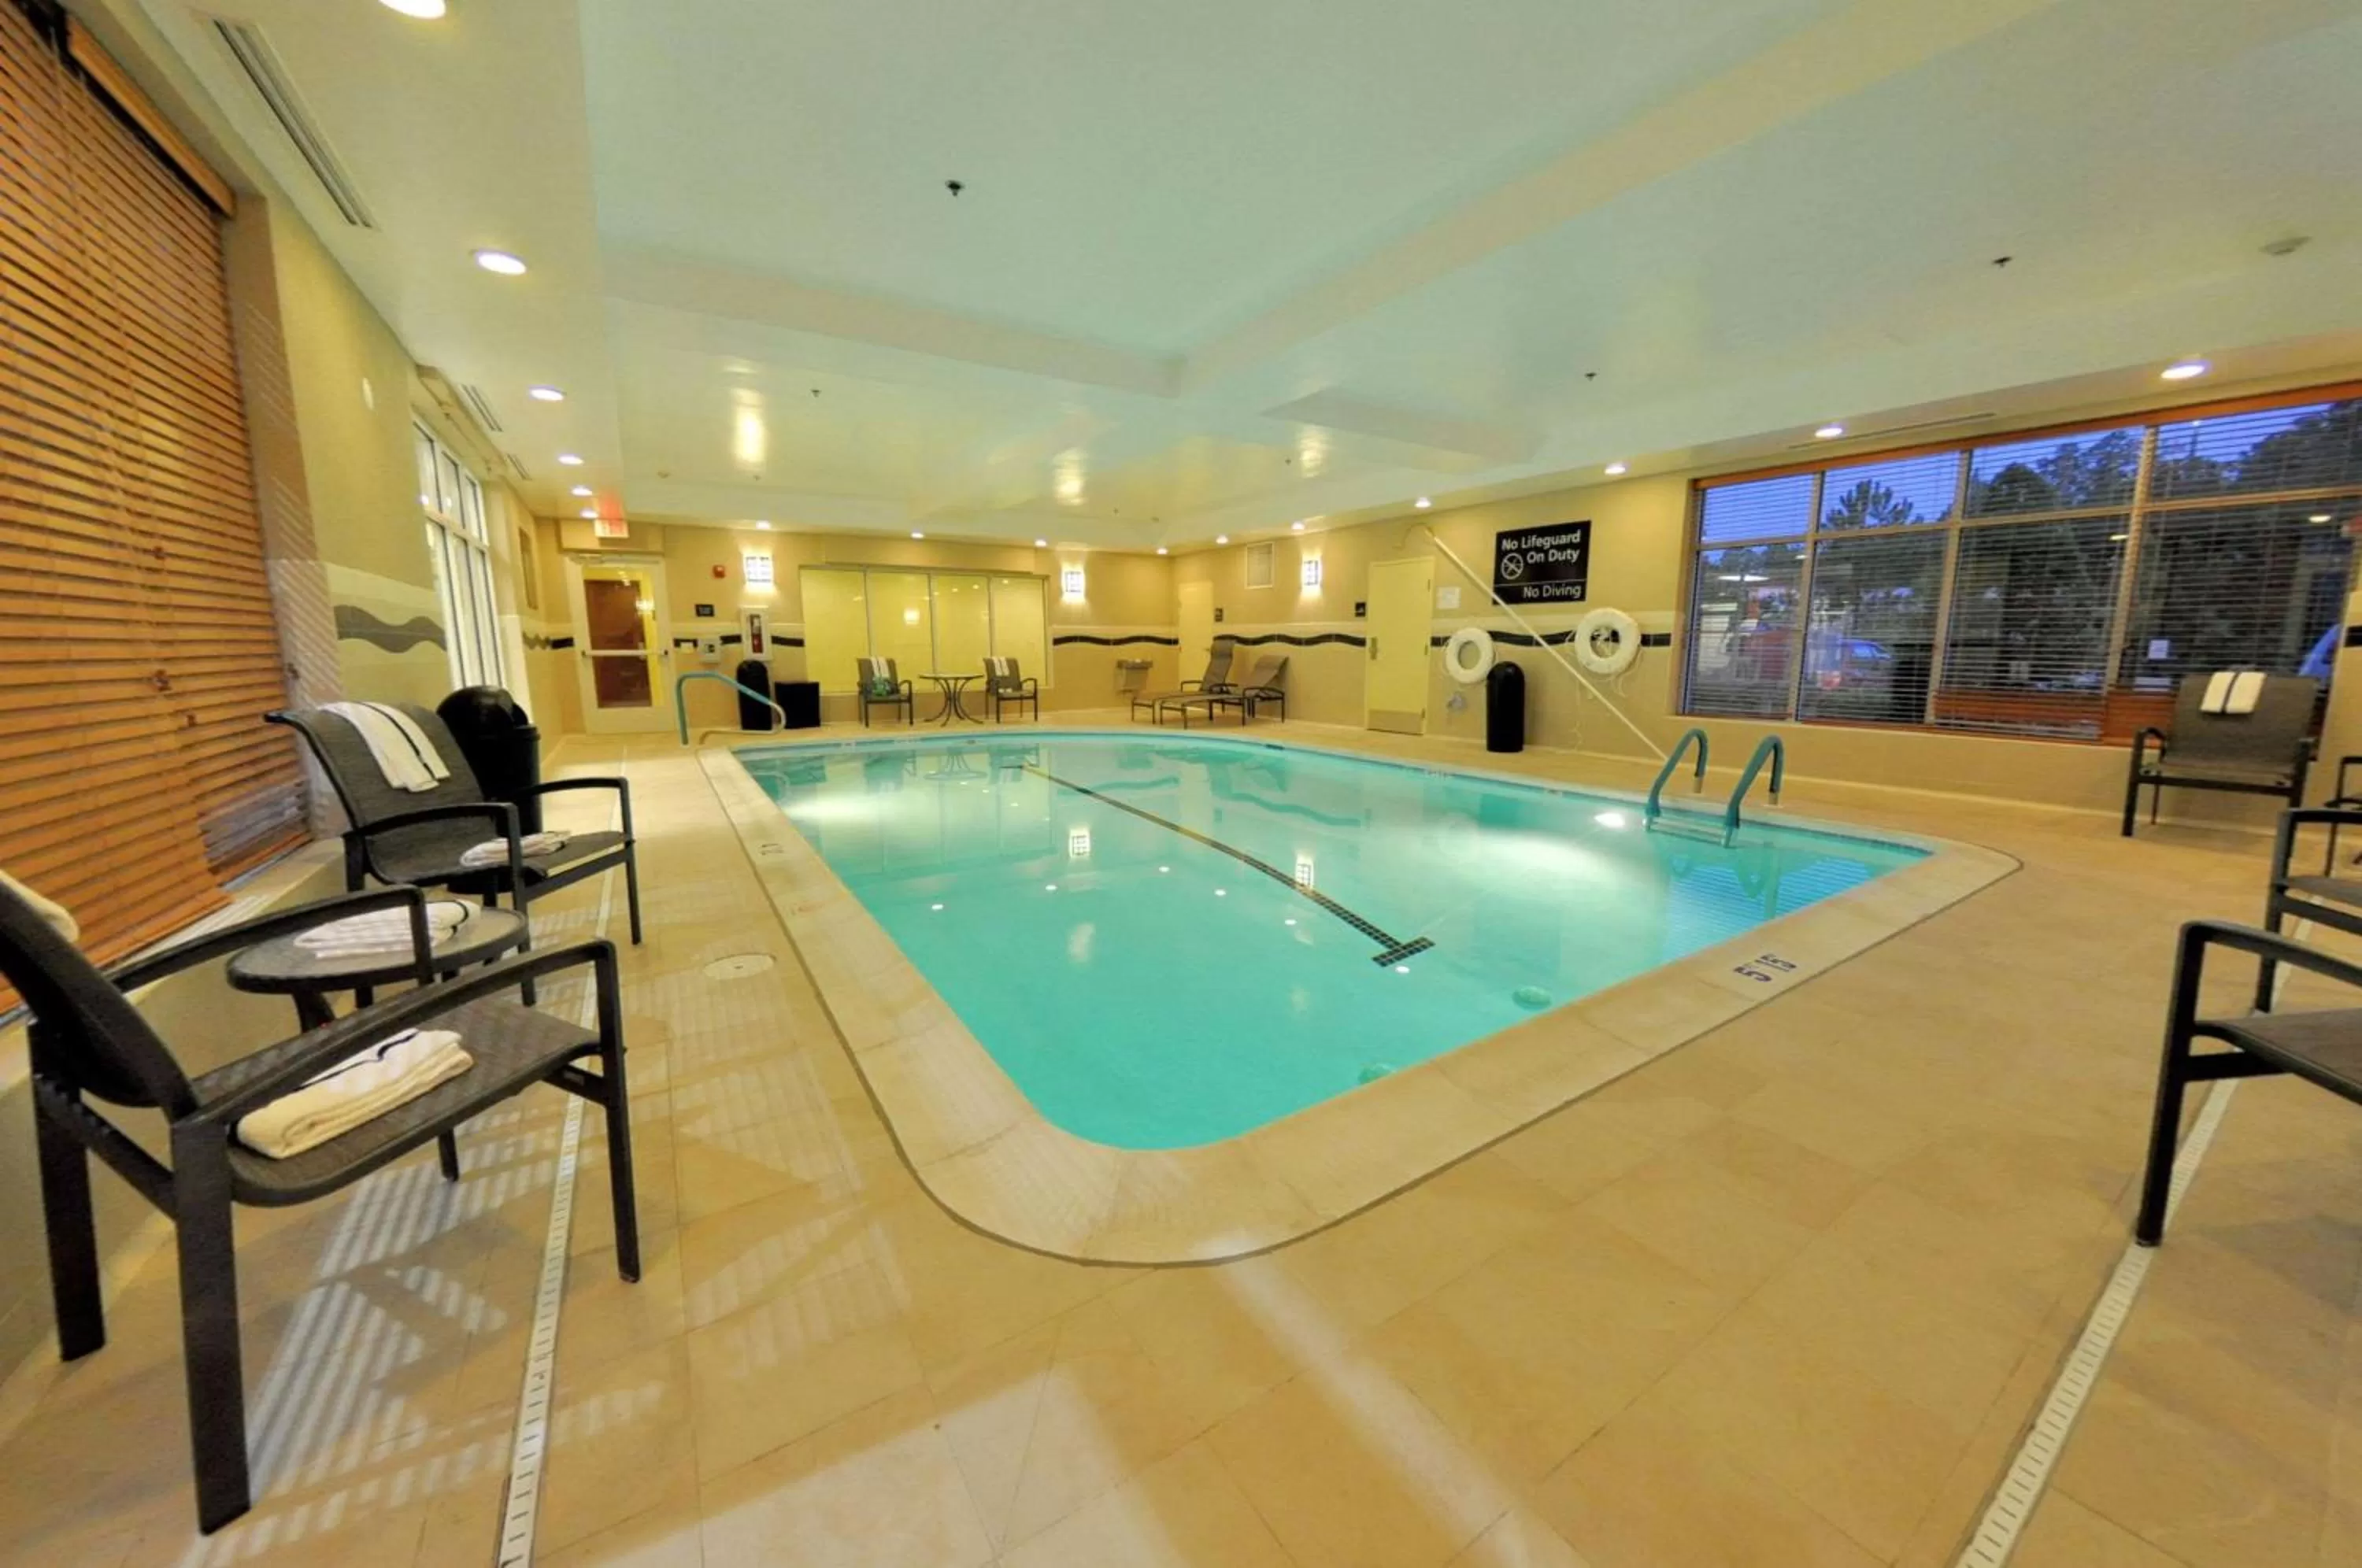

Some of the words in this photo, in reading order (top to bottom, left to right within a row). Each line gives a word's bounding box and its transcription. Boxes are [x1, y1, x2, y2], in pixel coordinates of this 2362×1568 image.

[1501, 538, 1519, 550] No
[1521, 529, 1581, 550] Lifeguard
[1527, 552, 1544, 564] On
[1548, 549, 1580, 563] Duty
[1523, 586, 1539, 598] No
[1542, 584, 1582, 598] Diving
